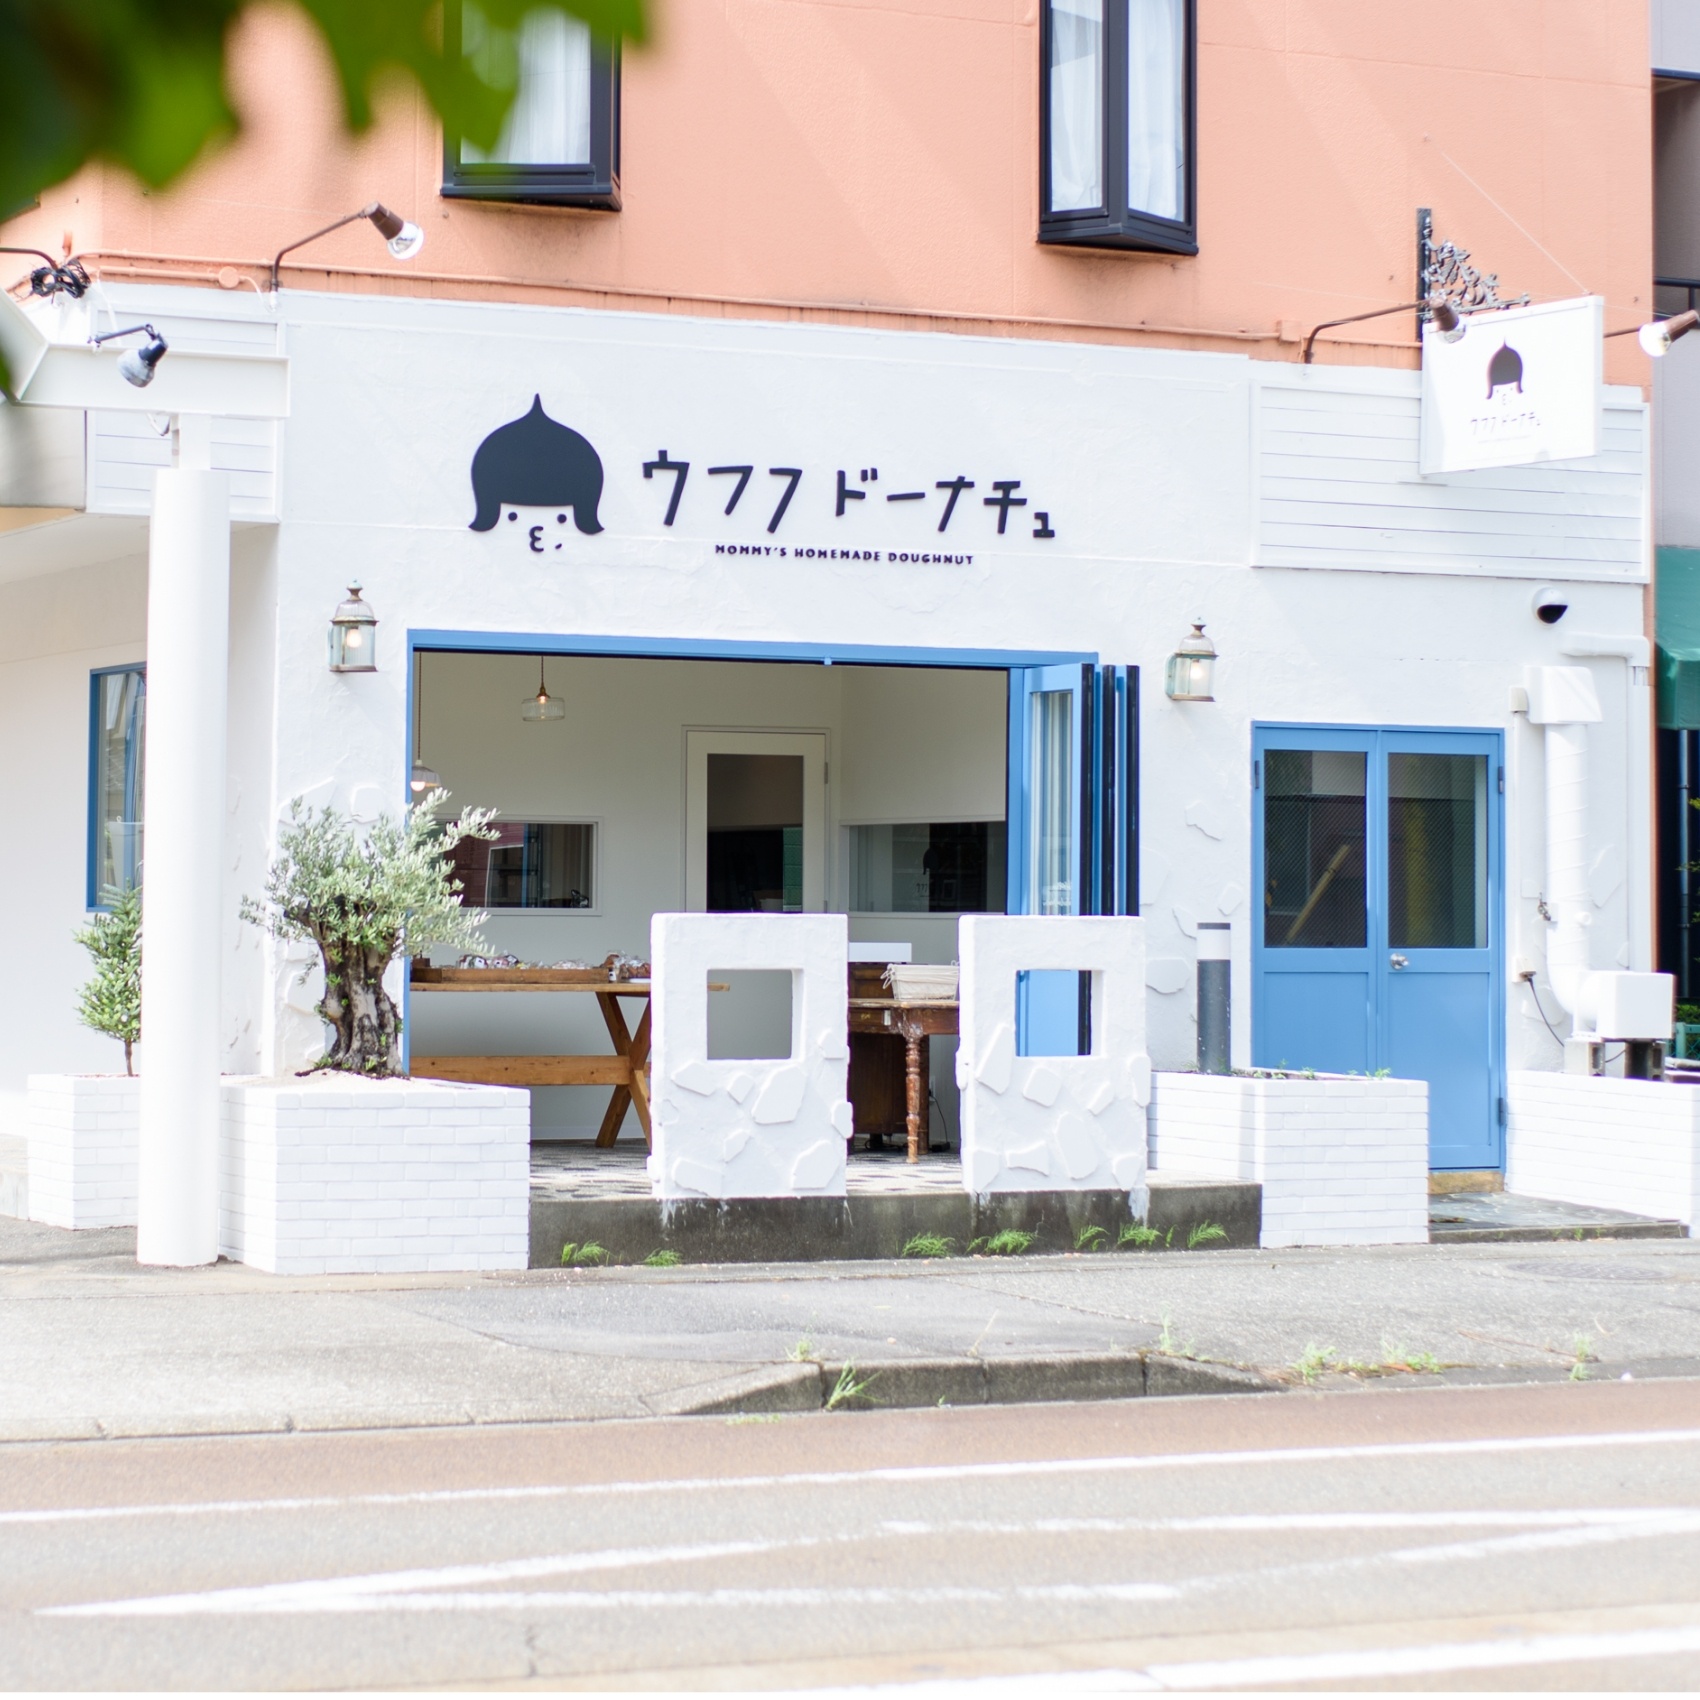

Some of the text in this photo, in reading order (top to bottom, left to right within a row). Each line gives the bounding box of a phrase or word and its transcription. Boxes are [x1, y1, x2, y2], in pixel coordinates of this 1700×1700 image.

[643, 450, 1056, 539] ウフフ ドーナチュ
[715, 544, 972, 565] MOMMY'S HOMEMADE DOUGHNUT
